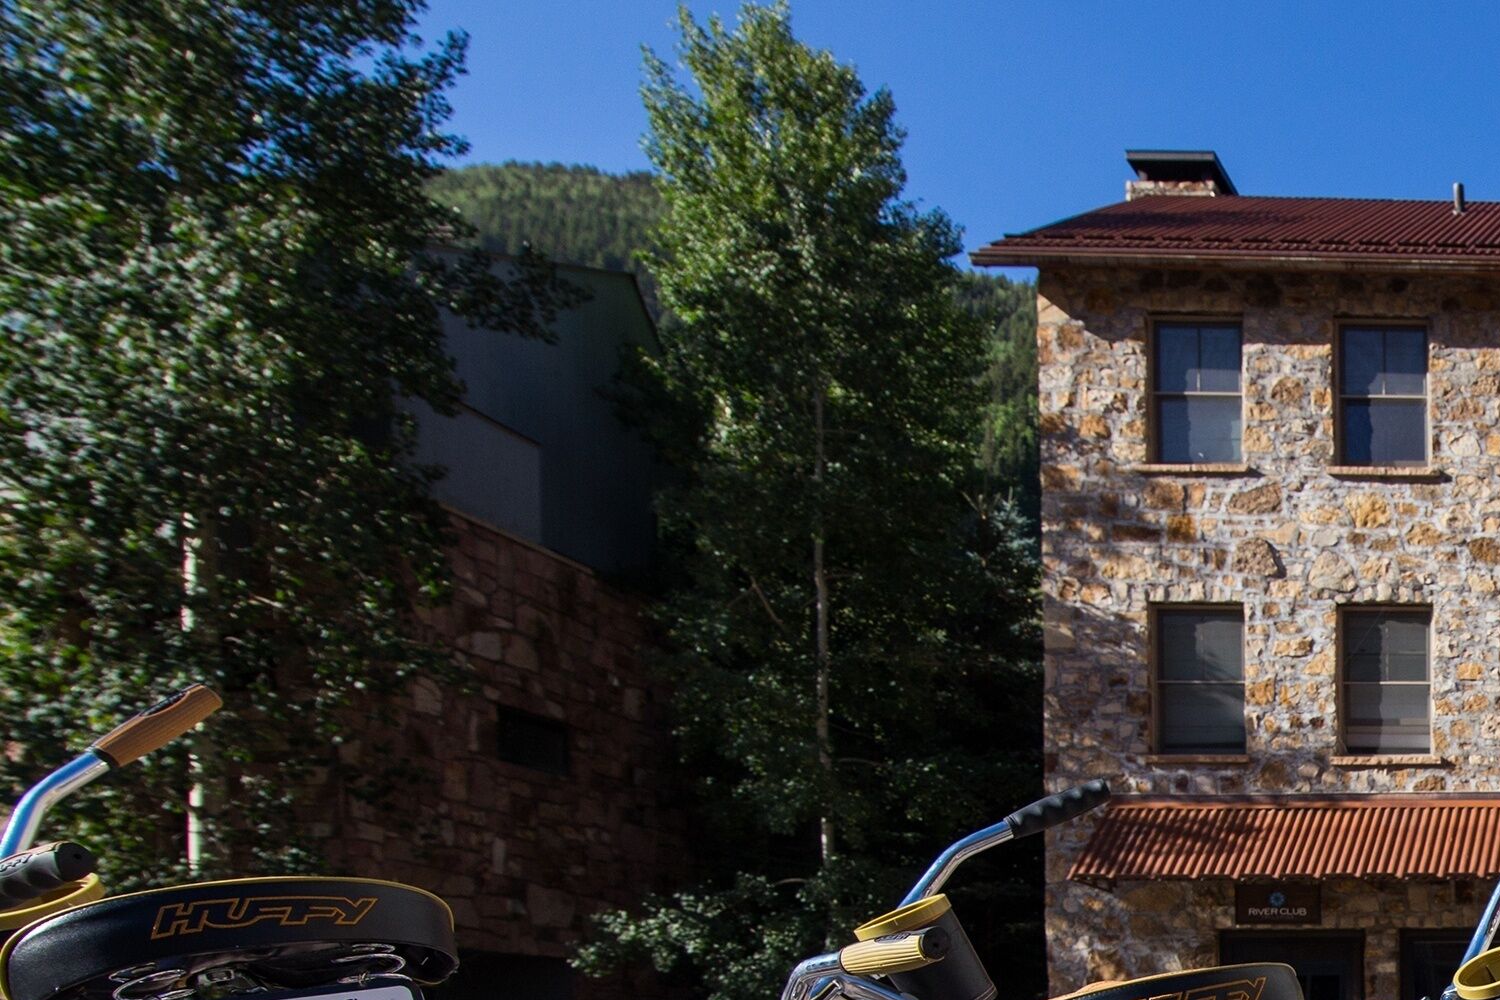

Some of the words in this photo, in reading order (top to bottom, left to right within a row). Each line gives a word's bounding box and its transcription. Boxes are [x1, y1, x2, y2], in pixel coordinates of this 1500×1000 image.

[150, 896, 379, 940] HUFFY
[1248, 907, 1278, 916] RIVER
[1279, 907, 1307, 916] CLUB
